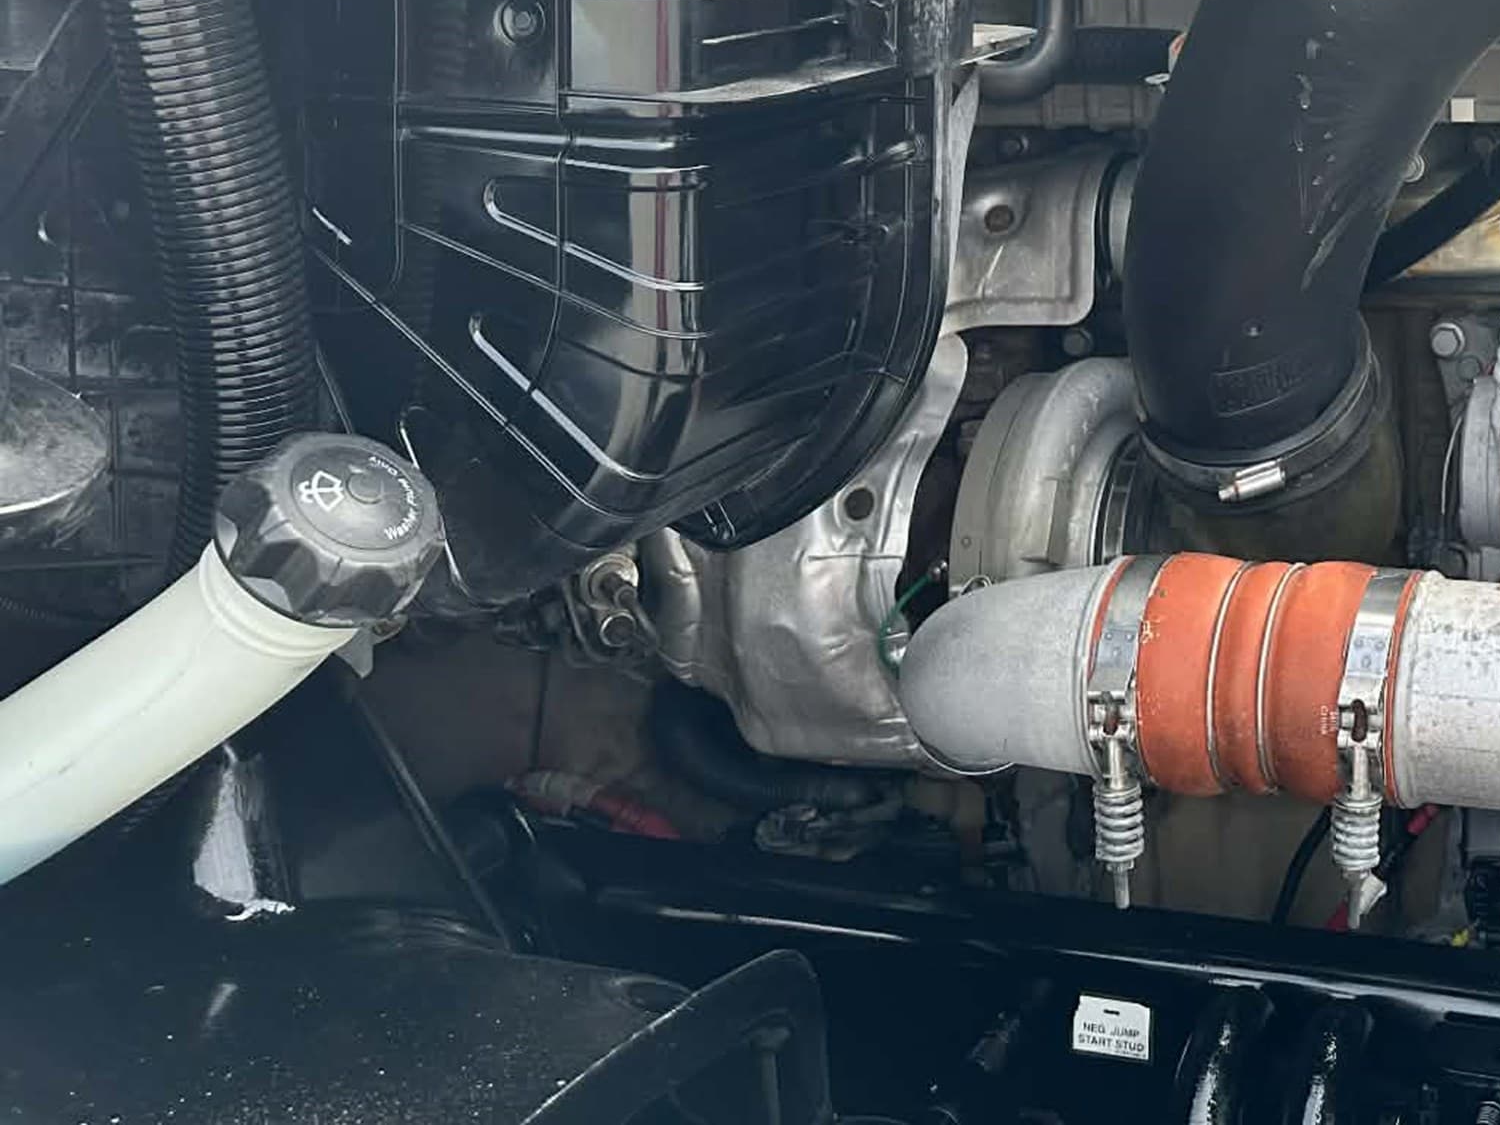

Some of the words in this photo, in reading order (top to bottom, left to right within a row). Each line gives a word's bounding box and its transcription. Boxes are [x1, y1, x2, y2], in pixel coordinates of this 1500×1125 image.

[1083, 1021, 1105, 1034] NEG
[1110, 1026, 1140, 1037] JUMP
[1079, 1033, 1112, 1047] START
[1115, 1039, 1145, 1052] STUD
